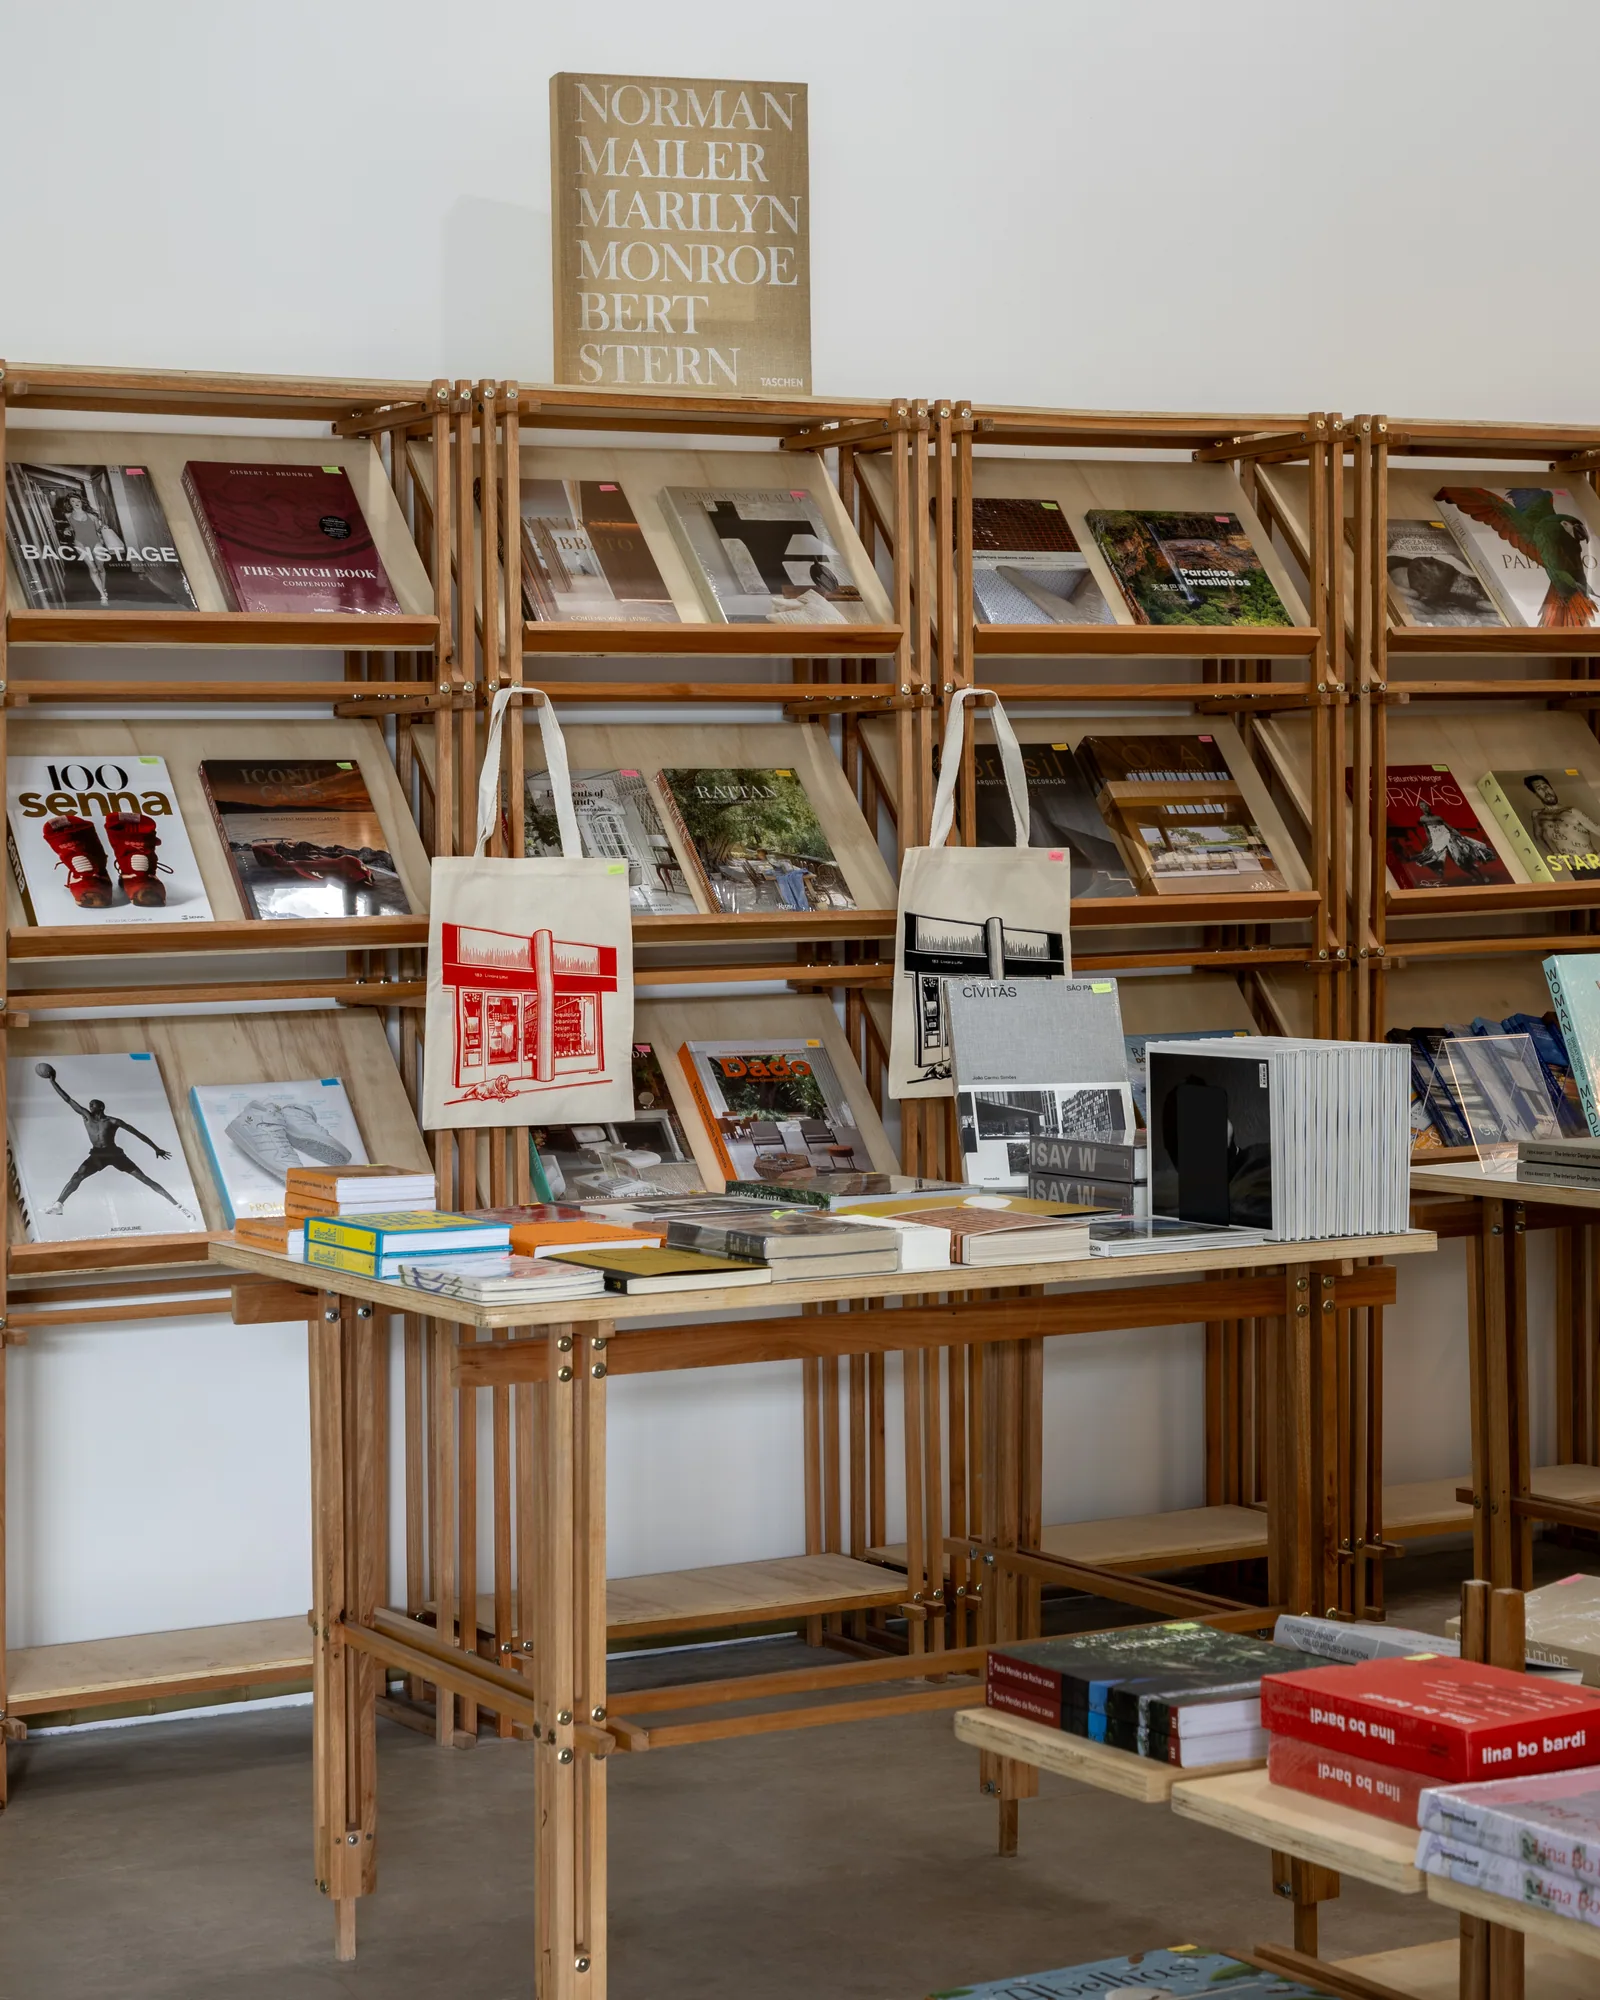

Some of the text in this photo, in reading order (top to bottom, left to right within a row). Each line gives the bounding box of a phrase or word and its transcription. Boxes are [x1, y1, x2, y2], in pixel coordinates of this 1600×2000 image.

[574, 83, 798, 131] NORMAN
[574, 135, 769, 182] MAILER
[575, 187, 802, 235] MARILYN
[575, 239, 798, 286] MONROE
[576, 291, 709, 334] BERT
[578, 343, 740, 386] STERN
[760, 377, 803, 388] TASCHEN
[20, 544, 179, 563] BACKSTAGE
[240, 566, 376, 579] THE WATCH BOOK
[282, 580, 345, 588] COMPENDIUM
[1184, 577, 1251, 586] brasileiros
[46, 764, 129, 791] 100
[240, 768, 326, 784] ICONIC
[975, 752, 1064, 777] Brsil
[18, 791, 173, 817] senna
[261, 785, 324, 801] CARS
[695, 785, 777, 799] RATTAN
[7, 835, 26, 894] senna
[1066, 984, 1082, 992] SÃO
[1546, 967, 1572, 1035] WOMAN
[720, 1055, 811, 1077] Dado
[1580, 1084, 1600, 1138] MADE
[1031, 1142, 1097, 1173] ISAY W
[6, 1139, 31, 1231] ORDAN
[1031, 1179, 1072, 1203] ISAY
[994, 1662, 1006, 1673] Paulo
[1006, 1666, 1022, 1679] Mendes
[1022, 1672, 1028, 1680] da
[994, 1691, 1006, 1703] Paulo
[1006, 1695, 1022, 1708] Mendes
[1022, 1701, 1028, 1710] da
[1309, 1707, 1396, 1746] lina bo bardi
[1482, 1729, 1586, 1764] lina bo bardi
[1317, 1762, 1400, 1803] lina bo bardi
[1571, 1851, 1594, 1873] Bo
[1578, 1890, 1600, 1916] Bo
